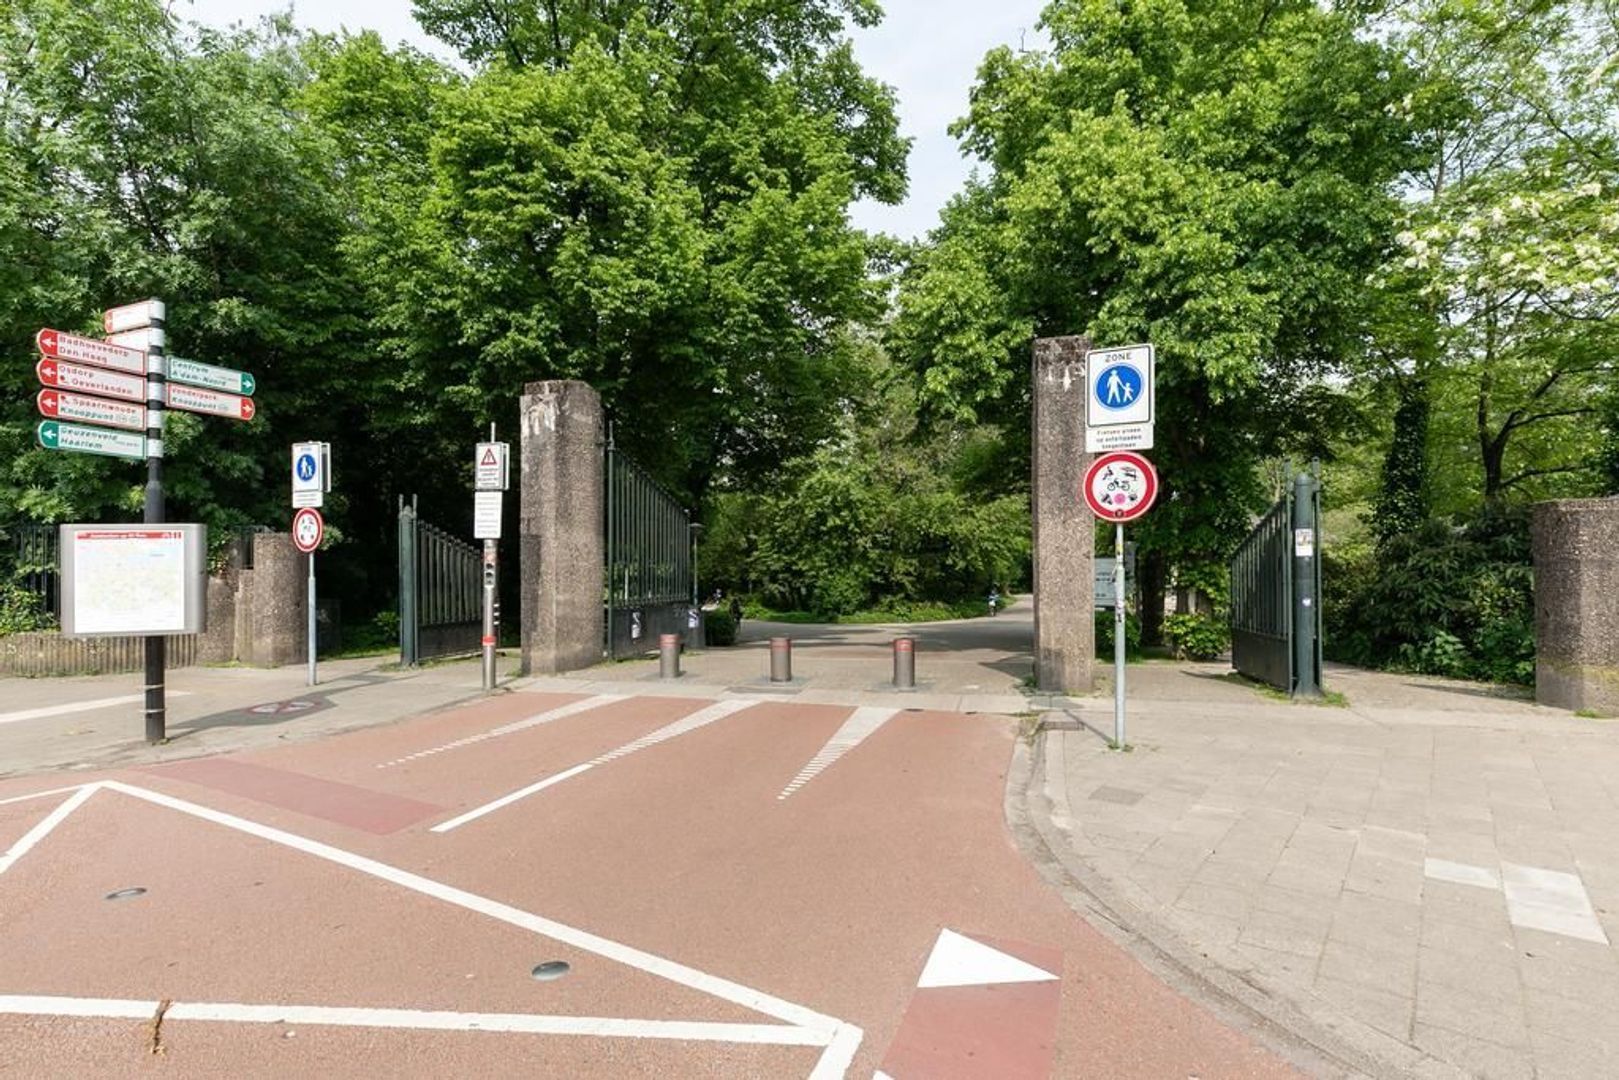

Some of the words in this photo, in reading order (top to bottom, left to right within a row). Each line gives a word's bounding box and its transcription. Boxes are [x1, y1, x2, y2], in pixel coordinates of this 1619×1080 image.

[60, 346, 79, 356] Den
[82, 352, 108, 364] Haag
[1105, 352, 1132, 363] ZONE
[59, 365, 94, 378] Osdorp
[172, 360, 209, 373] Centrum
[60, 407, 114, 420] Knooppunt
[61, 427, 118, 441] Geuzenveld
[61, 438, 103, 449] Haarlem
